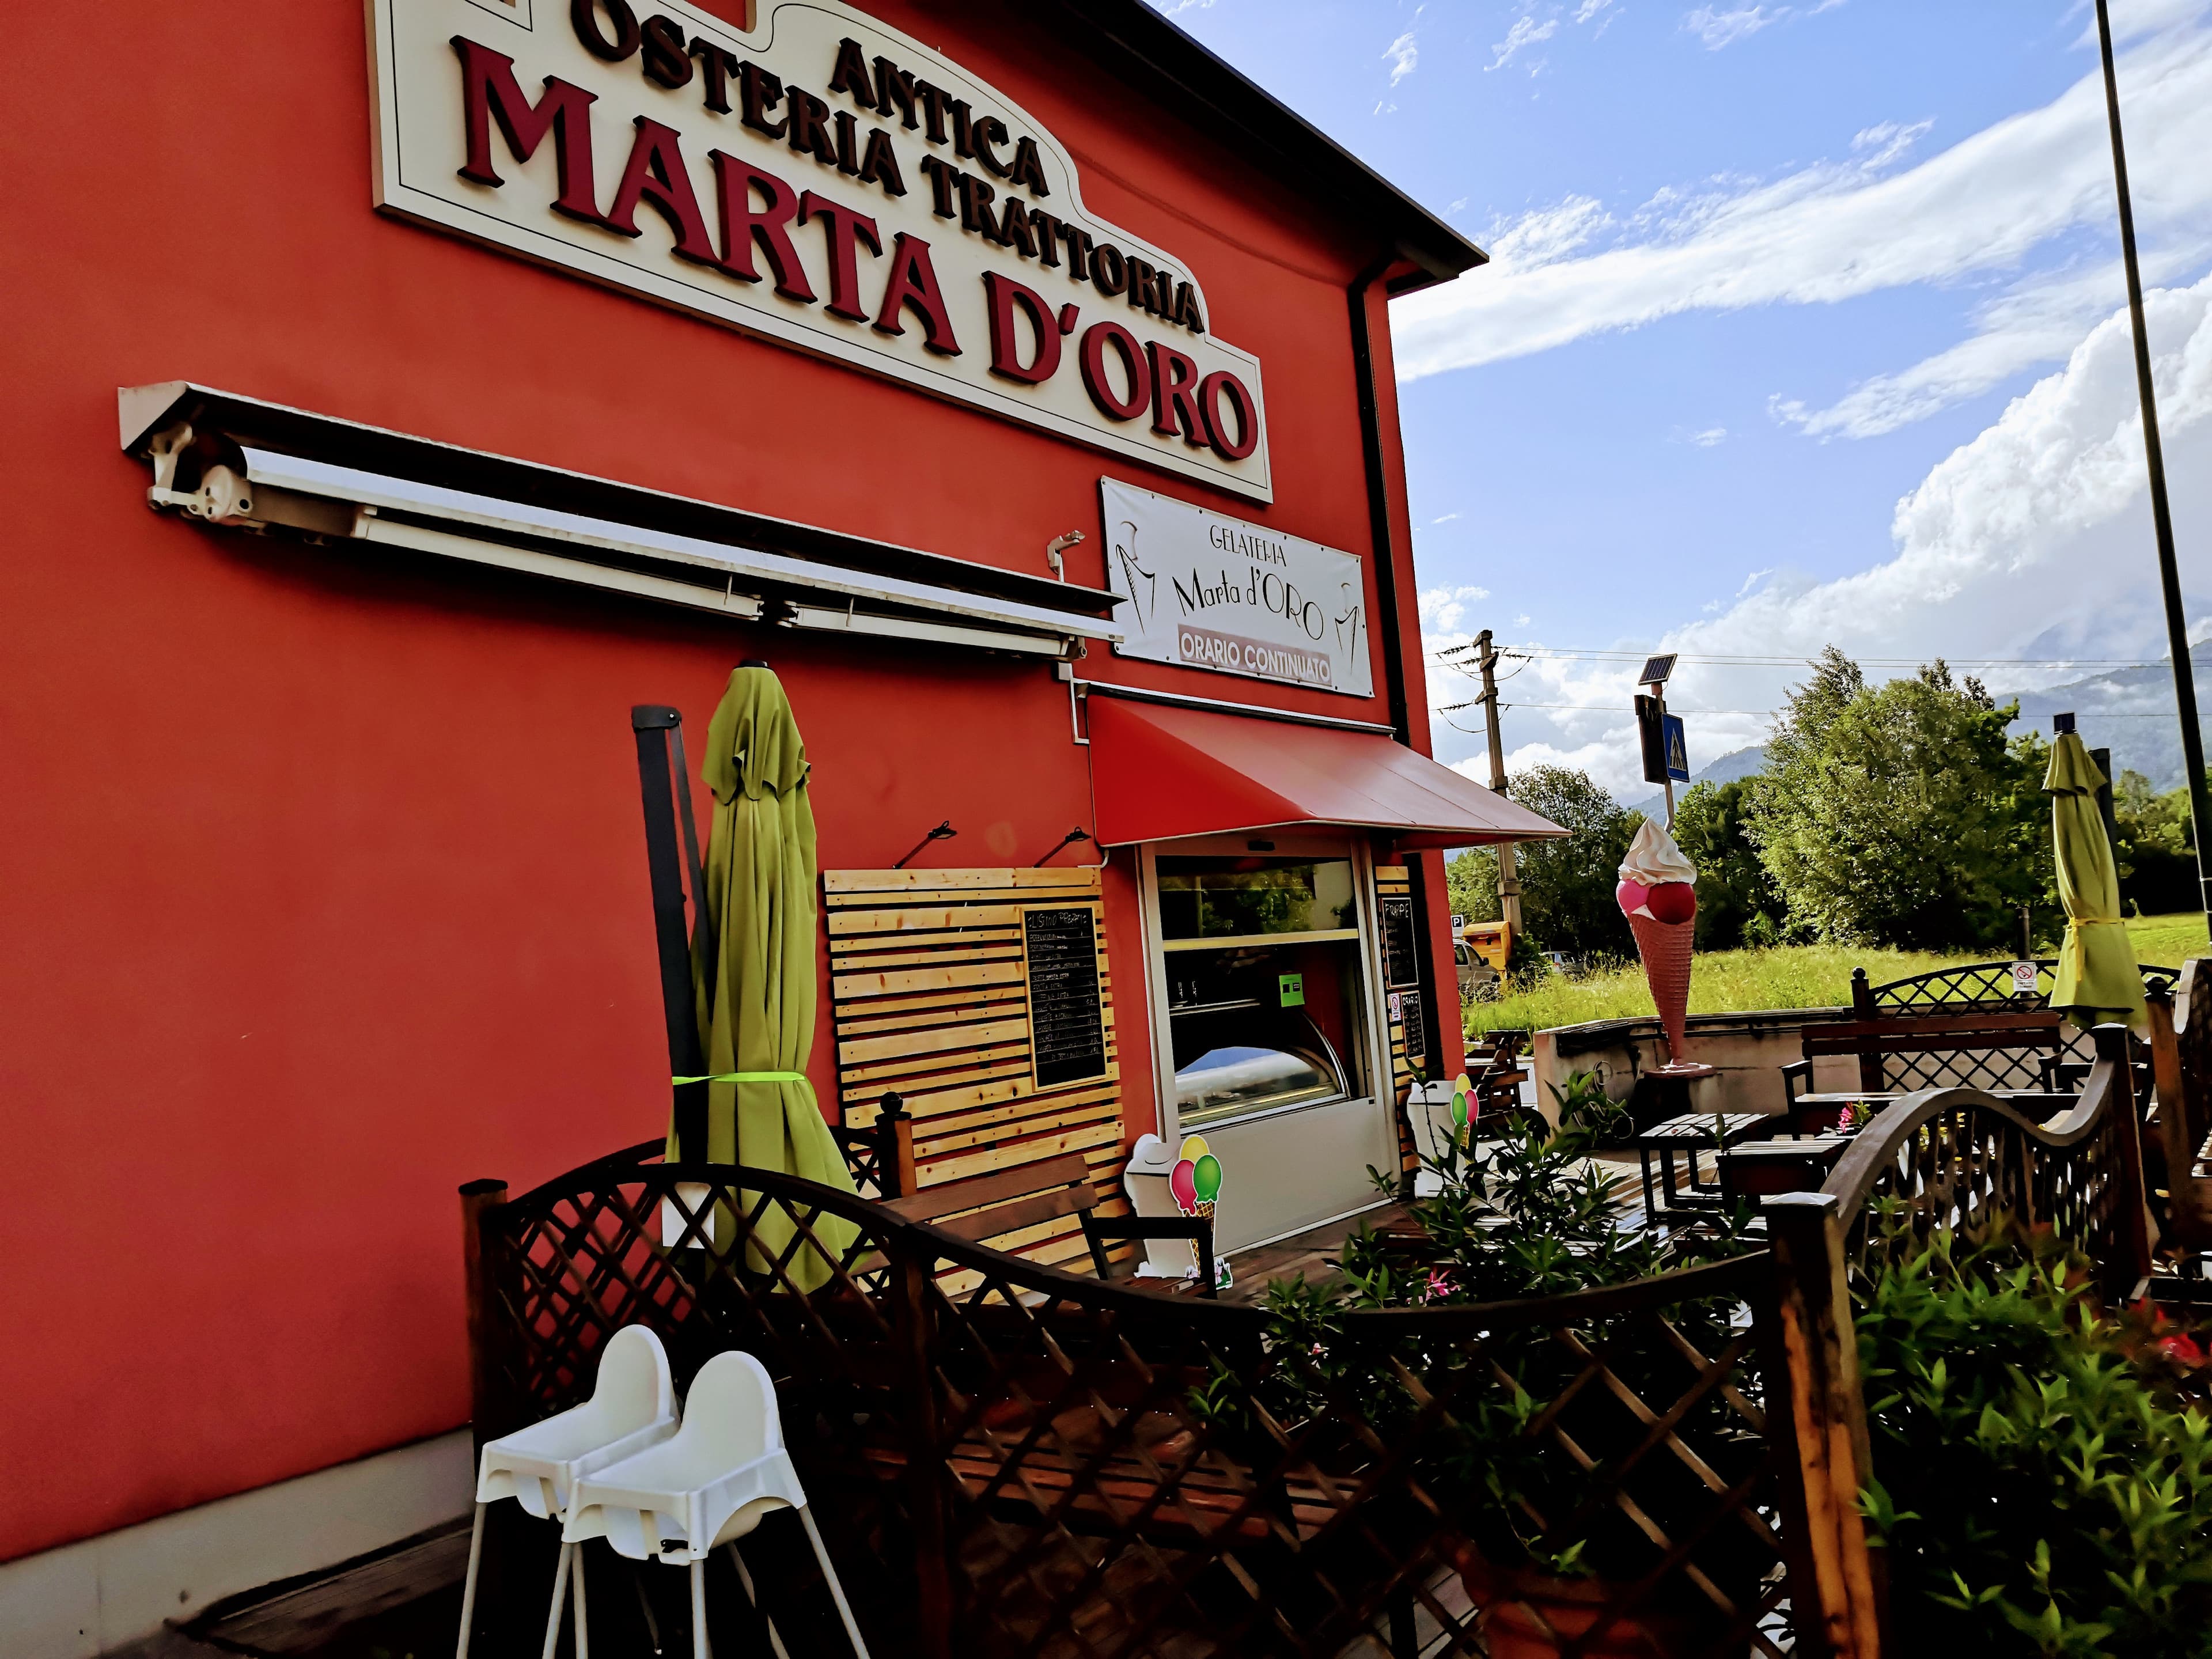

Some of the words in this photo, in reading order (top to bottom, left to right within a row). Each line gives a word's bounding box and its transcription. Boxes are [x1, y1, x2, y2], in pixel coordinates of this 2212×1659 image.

[828, 37, 1050, 197] ANTICA
[570, 0, 907, 197] OSTERIA
[921, 154, 1206, 334] TRATTORIA
[449, 35, 962, 357] MARTA
[982, 270, 1257, 461] D'ORO
[1210, 525, 1286, 566] GELATERIA
[1172, 567, 1241, 616] Marta
[1247, 566, 1324, 641] d'ORO
[1181, 632, 1240, 665] ORARIO
[1244, 645, 1331, 683] CONTINUATO
[1453, 918, 1460, 927] P
